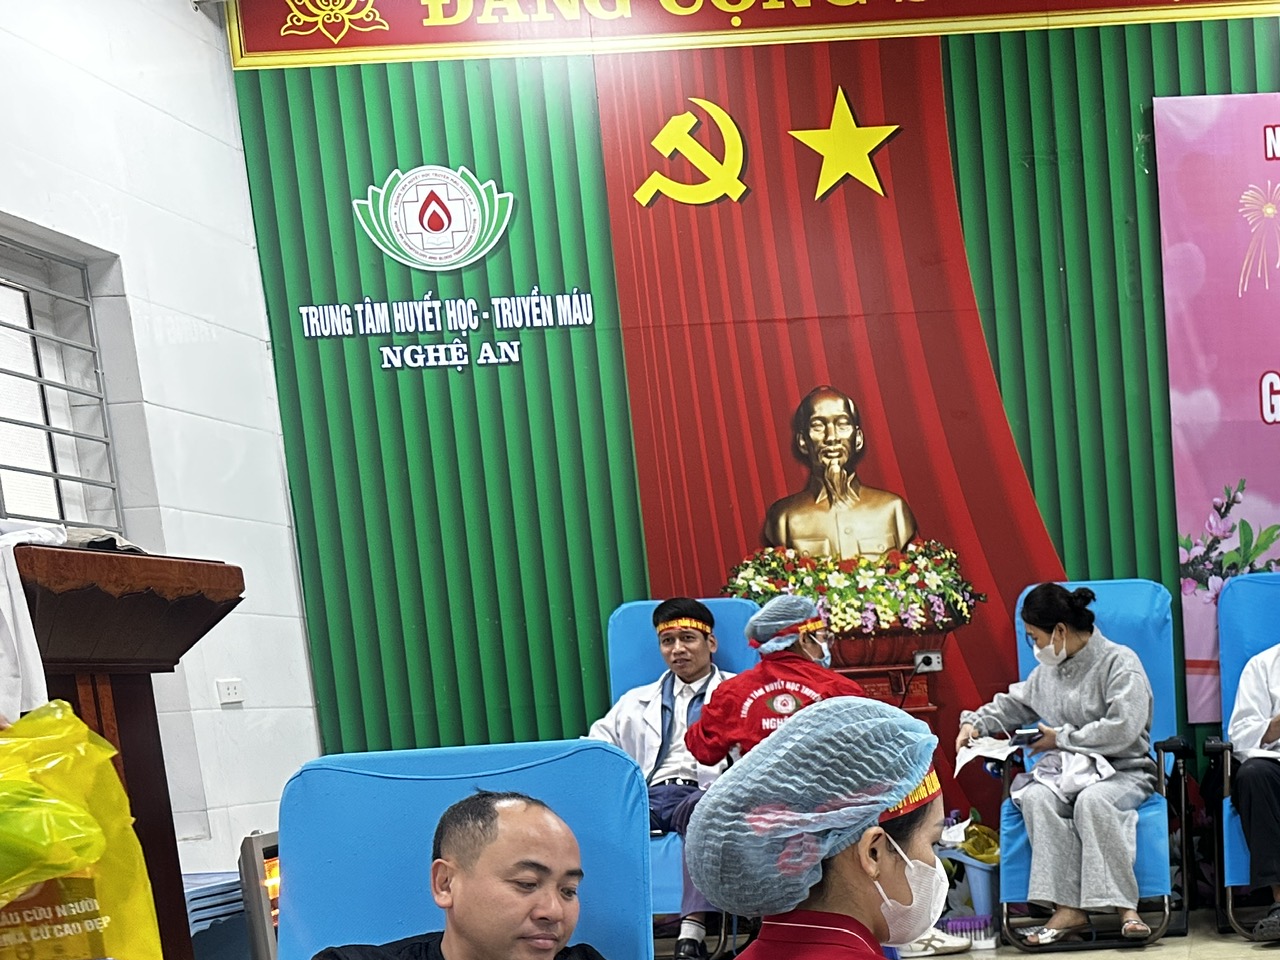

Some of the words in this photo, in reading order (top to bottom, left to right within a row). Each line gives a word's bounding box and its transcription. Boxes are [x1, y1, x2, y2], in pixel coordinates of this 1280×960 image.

[299, 305, 353, 337] TRUNG
[355, 296, 390, 334] TÂM
[393, 291, 441, 333] HUYẾT
[446, 298, 478, 336] HỌC
[491, 286, 553, 328] TRUYỀN
[556, 288, 593, 326] MÁU
[380, 338, 468, 371] NGHỆ
[477, 341, 520, 364] AN
[761, 716, 789, 730] NGH
